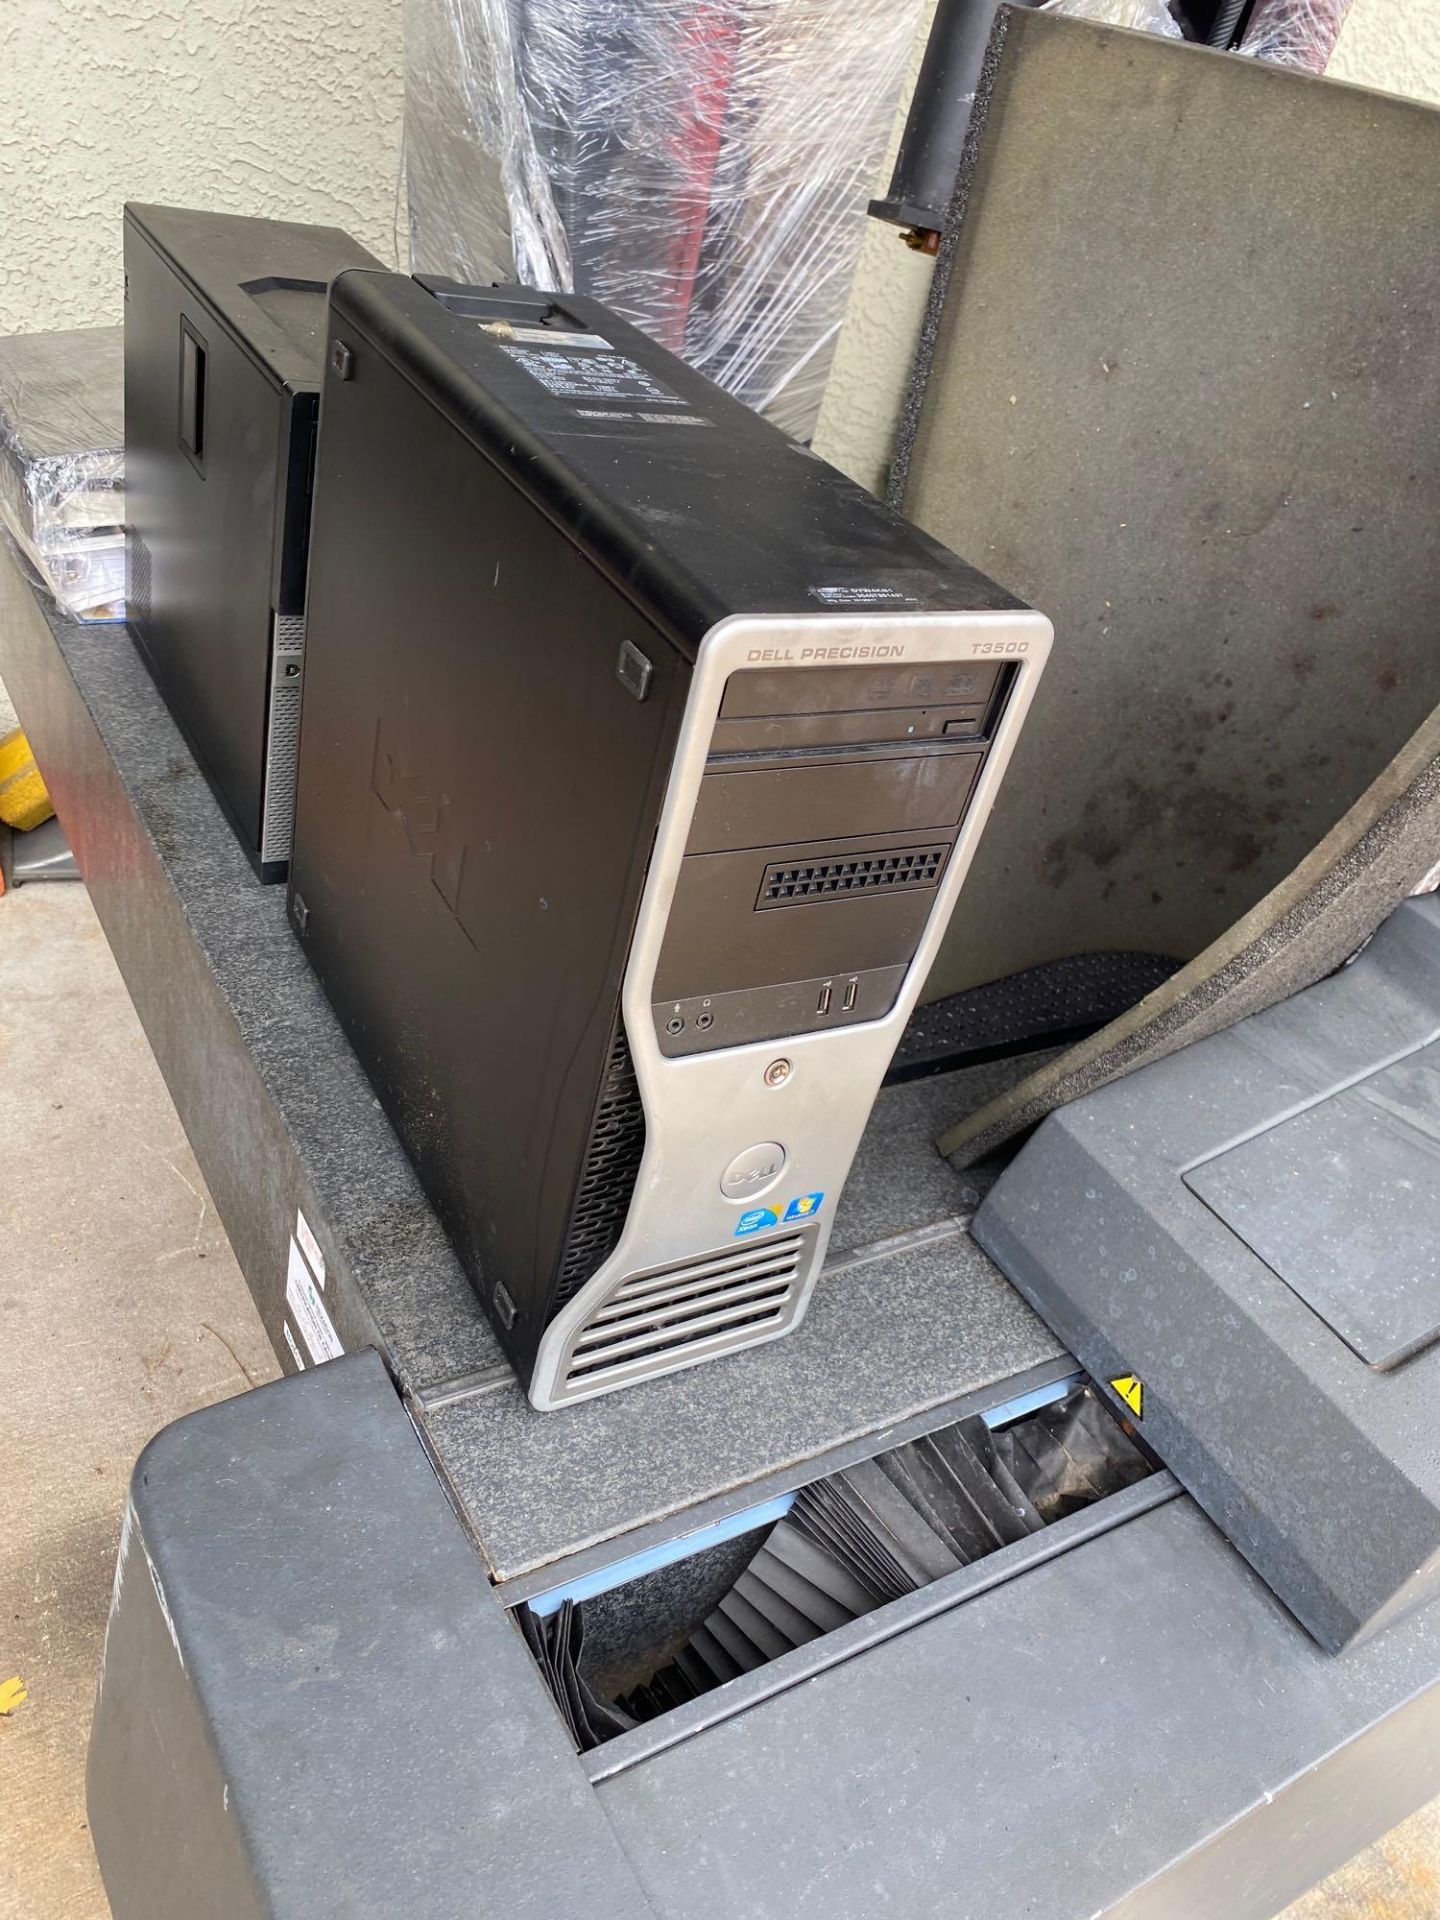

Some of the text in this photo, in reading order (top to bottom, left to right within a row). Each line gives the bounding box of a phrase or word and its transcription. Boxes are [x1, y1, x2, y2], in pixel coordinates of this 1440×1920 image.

[747, 646, 904, 661] DELL PRECISION
[971, 642, 1029, 655] T3500
